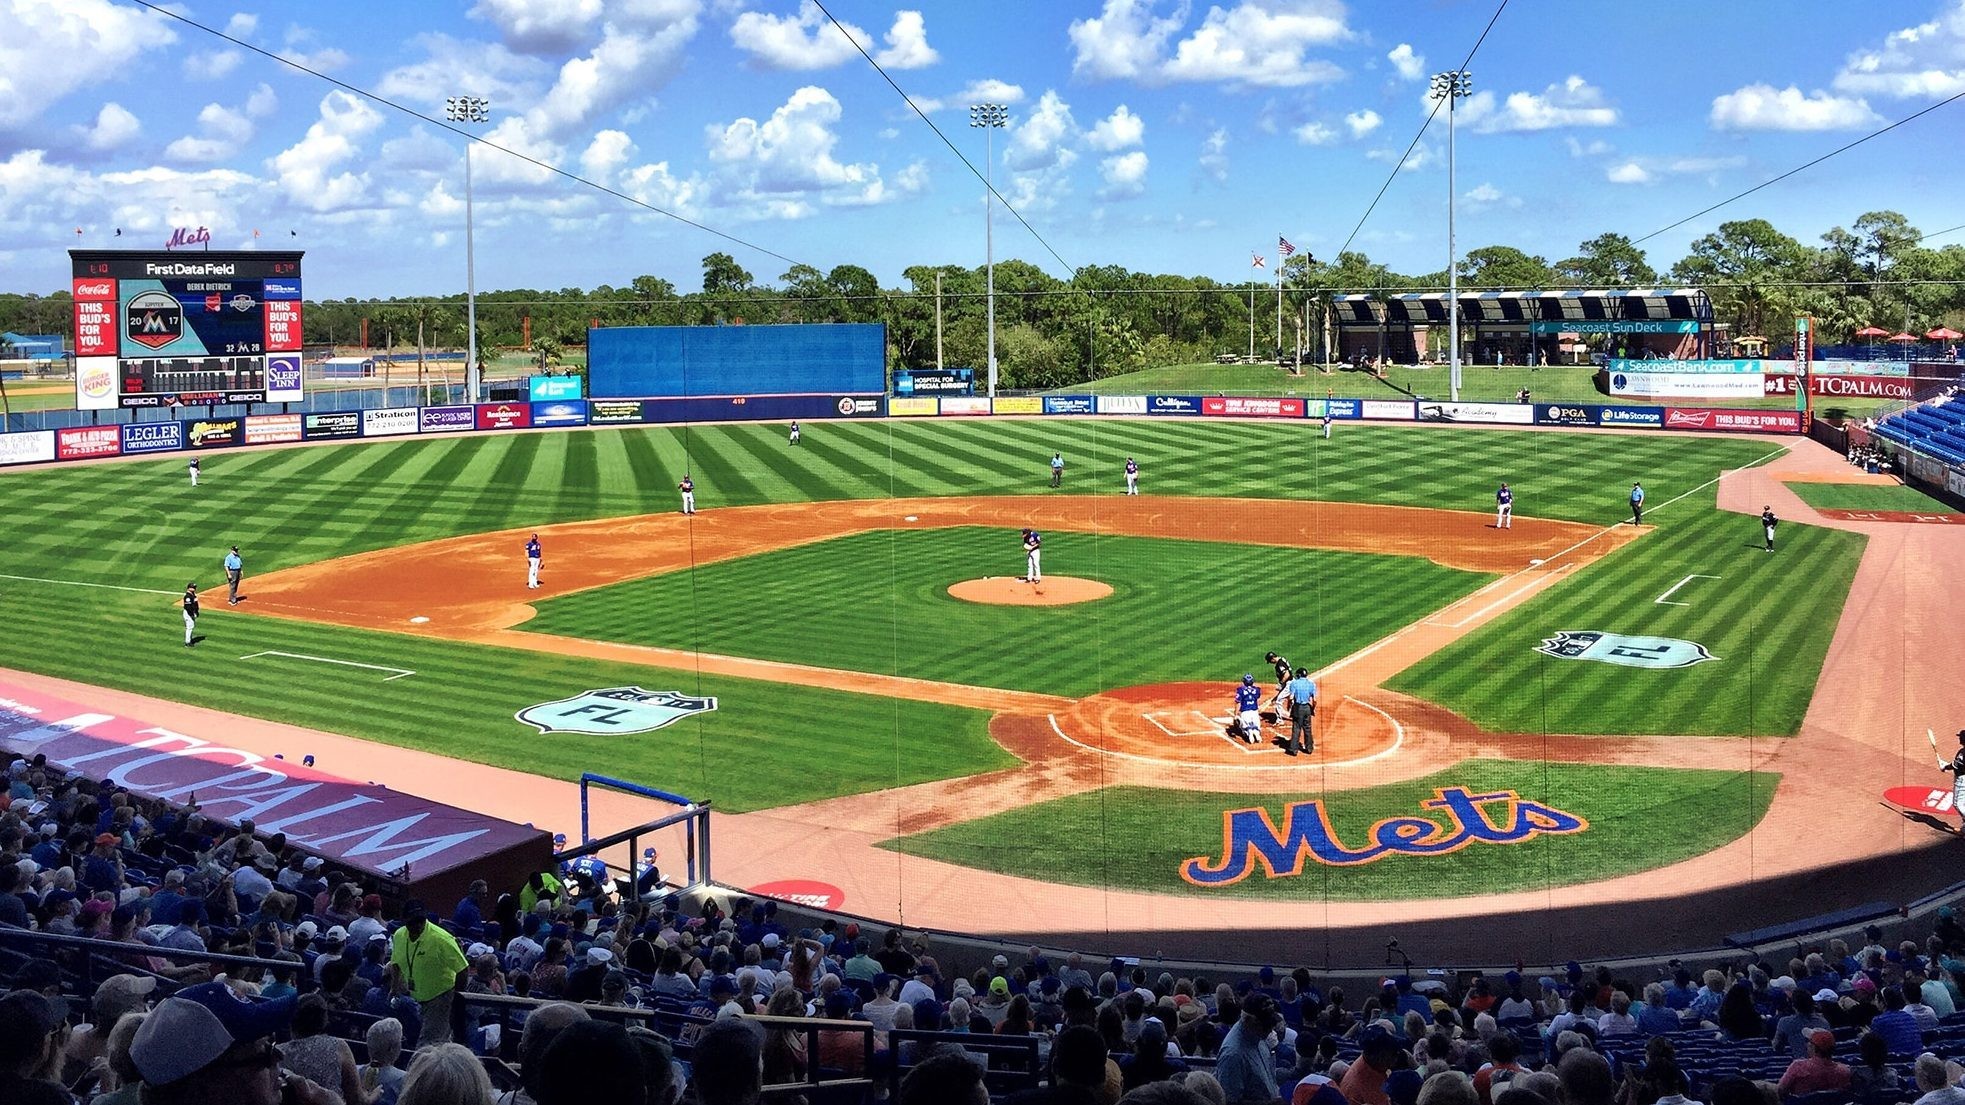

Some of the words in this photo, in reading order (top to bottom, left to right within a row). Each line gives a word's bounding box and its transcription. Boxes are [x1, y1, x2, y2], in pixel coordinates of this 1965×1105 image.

[166, 226, 211, 247] Mets
[146, 264, 174, 275] First
[174, 264, 204, 275] Data
[205, 264, 234, 275] Field
[187, 283, 205, 291] DEREK
[206, 283, 231, 291] DIETRICH
[79, 303, 103, 313] THIS
[270, 302, 290, 311] THIS
[80, 314, 110, 324] BUD'S
[130, 317, 142, 326] 20
[169, 316, 178, 325] 17
[270, 312, 297, 322] BUD'S
[80, 325, 100, 335] FOR
[270, 323, 288, 332] FOR
[1562, 322, 1610, 333] Seacoast
[1612, 322, 1634, 333] Sun
[1635, 322, 1662, 333] Deck
[80, 336, 104, 346] YOU.
[270, 333, 291, 342] YOU.
[226, 344, 234, 352] 32
[1628, 360, 1735, 372] SeacoastBank.com
[82, 372, 109, 382] BURGER
[84, 378, 111, 392] KING
[276, 380, 295, 388] INN
[1766, 378, 1786, 392] #1
[122, 397, 158, 405] GEICO
[1156, 397, 1191, 409] Culligan
[375, 411, 416, 420] Straticon
[1561, 409, 1586, 417] PGA
[1715, 415, 1734, 424] THIS
[1735, 415, 1759, 425] BUD'S
[1761, 416, 1777, 425] FOR
[1778, 417, 1798, 426] YOU.
[61, 431, 81, 445] FRANK
[100, 429, 118, 441] PIZZA
[125, 426, 179, 441] LEGLER
[127, 439, 177, 449] ORTHODONTICS
[1608, 645, 1671, 660] FL
[557, 704, 633, 725] FL
[1178, 786, 1590, 887] Mets
